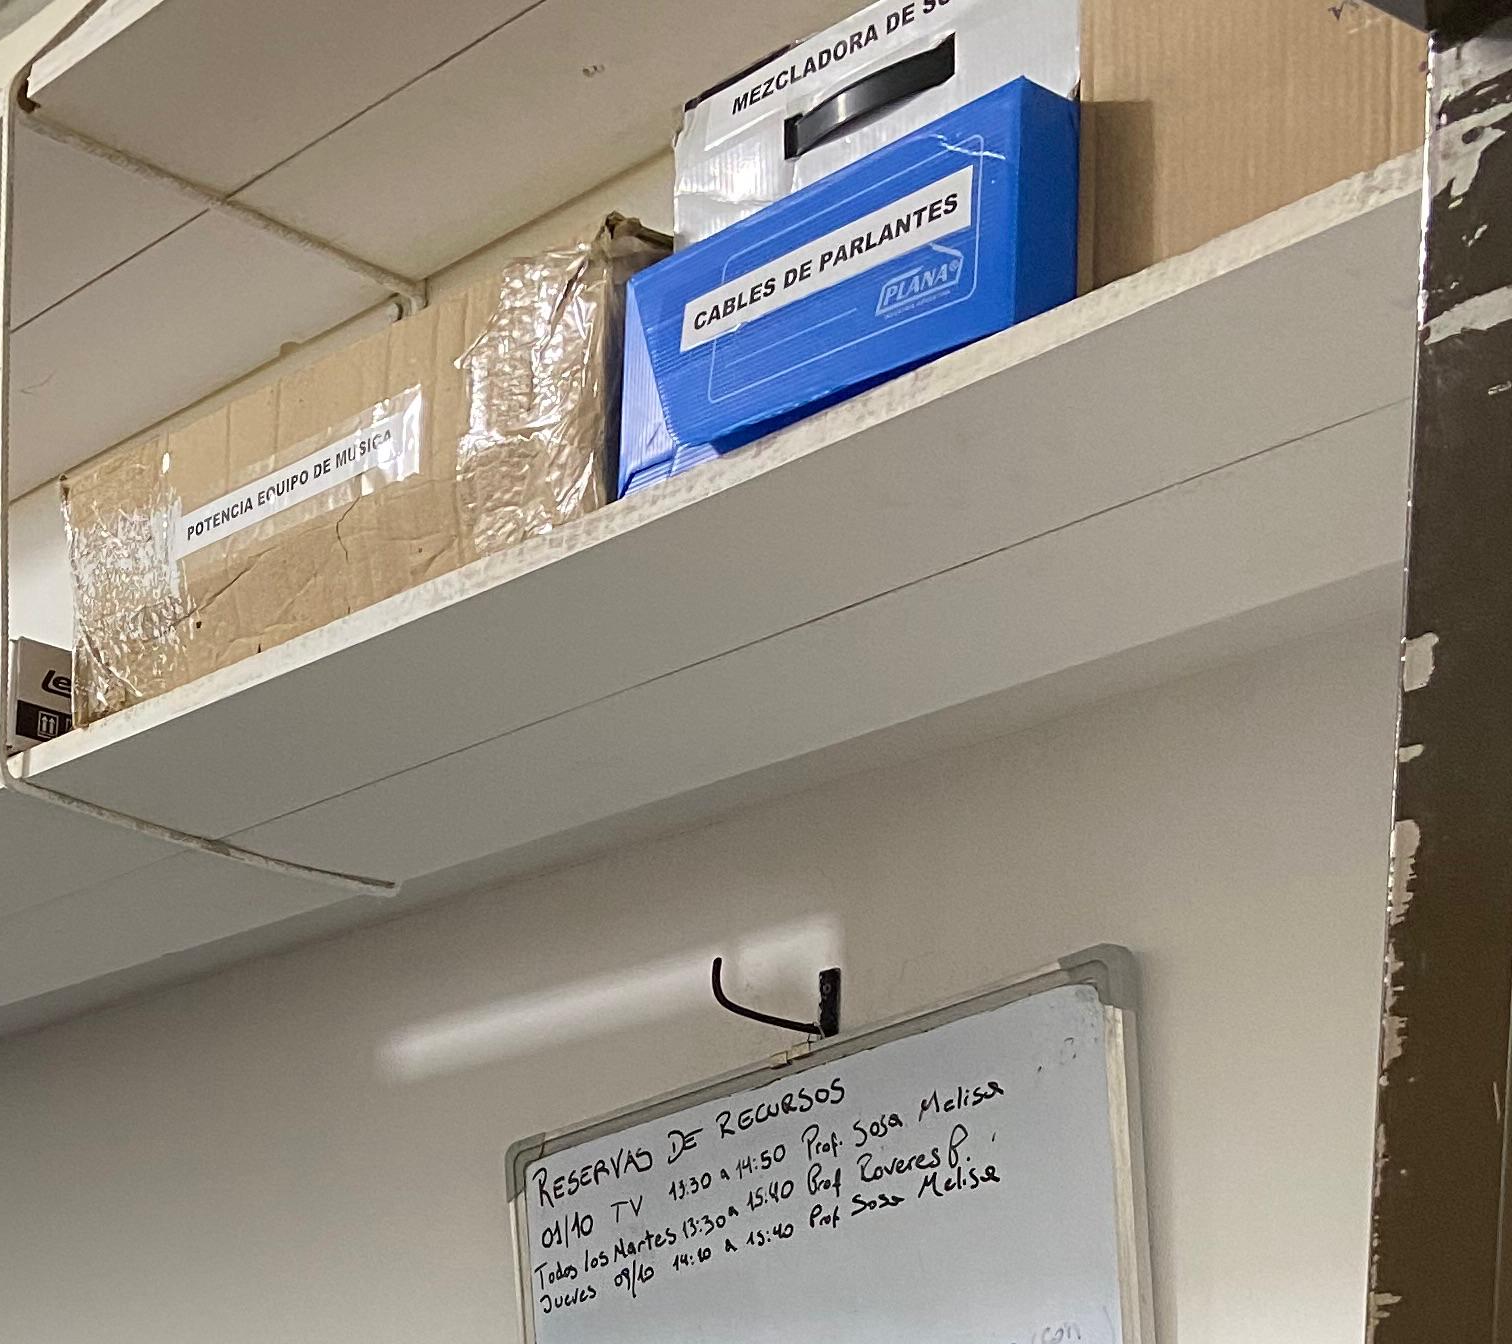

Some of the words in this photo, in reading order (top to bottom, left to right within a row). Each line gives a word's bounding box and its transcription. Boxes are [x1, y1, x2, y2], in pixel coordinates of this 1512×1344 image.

[732, 24, 878, 115] MEZCLADORA
[886, 3, 915, 35] DE
[693, 278, 775, 330] CABLES
[783, 260, 813, 289] DE
[819, 193, 958, 272] PARLANTES
[884, 264, 948, 306] PLANA
[187, 497, 253, 540] POTENCIA
[257, 470, 309, 506] EQUIPO
[313, 458, 331, 479] DE
[533, 1147, 653, 1208] RESERVAS
[666, 1127, 704, 1164] DE
[716, 1078, 845, 1139] RECURSOS
[541, 1211, 594, 1248] 01/10
[611, 1195, 643, 1223] TV
[735, 1143, 786, 1180] 14:50
[801, 1123, 843, 1161] Prof.
[852, 1113, 904, 1147] Sosa
[535, 1261, 578, 1290] Todos
[584, 1249, 609, 1272] los
[614, 1227, 677, 1262] Martes
[682, 1214, 726, 1240] 13:30
[539, 1285, 597, 1314] Jueves
[746, 1223, 794, 1247] 15:40
[809, 1203, 840, 1229] Prof
[851, 1193, 905, 1217] Sosa
